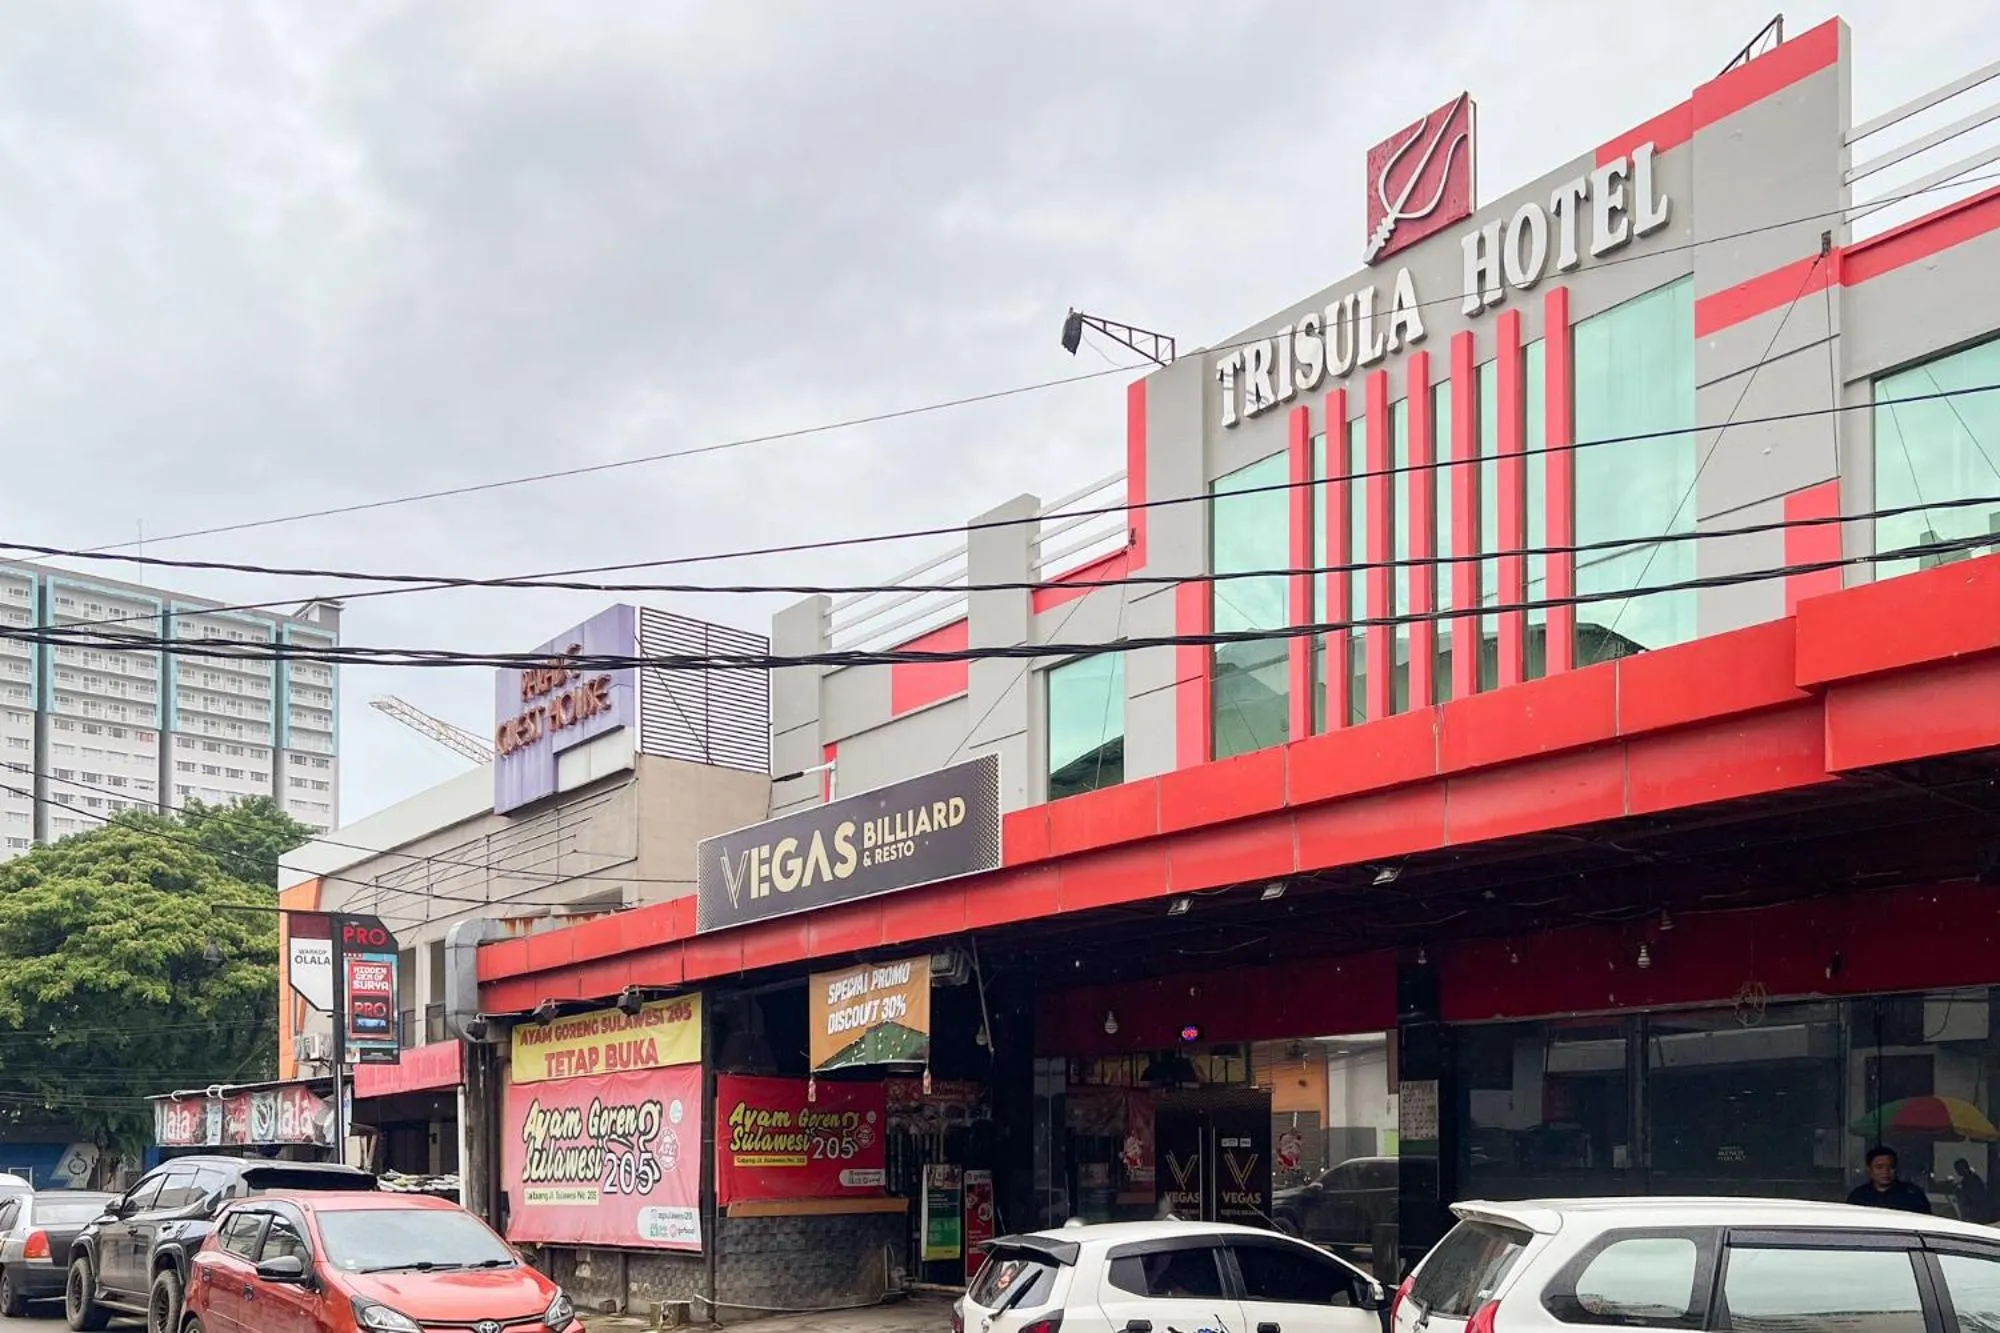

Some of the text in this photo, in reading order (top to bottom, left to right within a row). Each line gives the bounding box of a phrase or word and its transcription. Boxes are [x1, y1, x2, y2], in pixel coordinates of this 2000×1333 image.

[1215, 142, 1669, 428] TRISULA HOTEL
[863, 795, 966, 849] BILLIARD
[719, 821, 858, 909] VEGAS
[862, 839, 915, 866] & RESTO
[343, 926, 386, 946] PRO
[294, 955, 331, 966] OLALA
[352, 980, 389, 991] SURYA
[870, 962, 911, 991] PROMO
[353, 1001, 387, 1017] PRO
[881, 994, 907, 1019] 30%
[520, 1001, 693, 1046] AYAM GORENG SULAWESI 205
[544, 1037, 660, 1078] TETAP BUKA
[522, 1097, 583, 1150] Ayam
[586, 1096, 664, 1154] Goreng
[729, 1101, 860, 1141] Ayam Goreng
[730, 1125, 811, 1152] Sulawesi
[812, 1136, 854, 1160] 205
[522, 1136, 604, 1183] Sulawesi
[602, 1151, 655, 1195] 205
[1165, 1191, 1200, 1204] VEGAS
[1222, 1191, 1262, 1205] VEGAS
